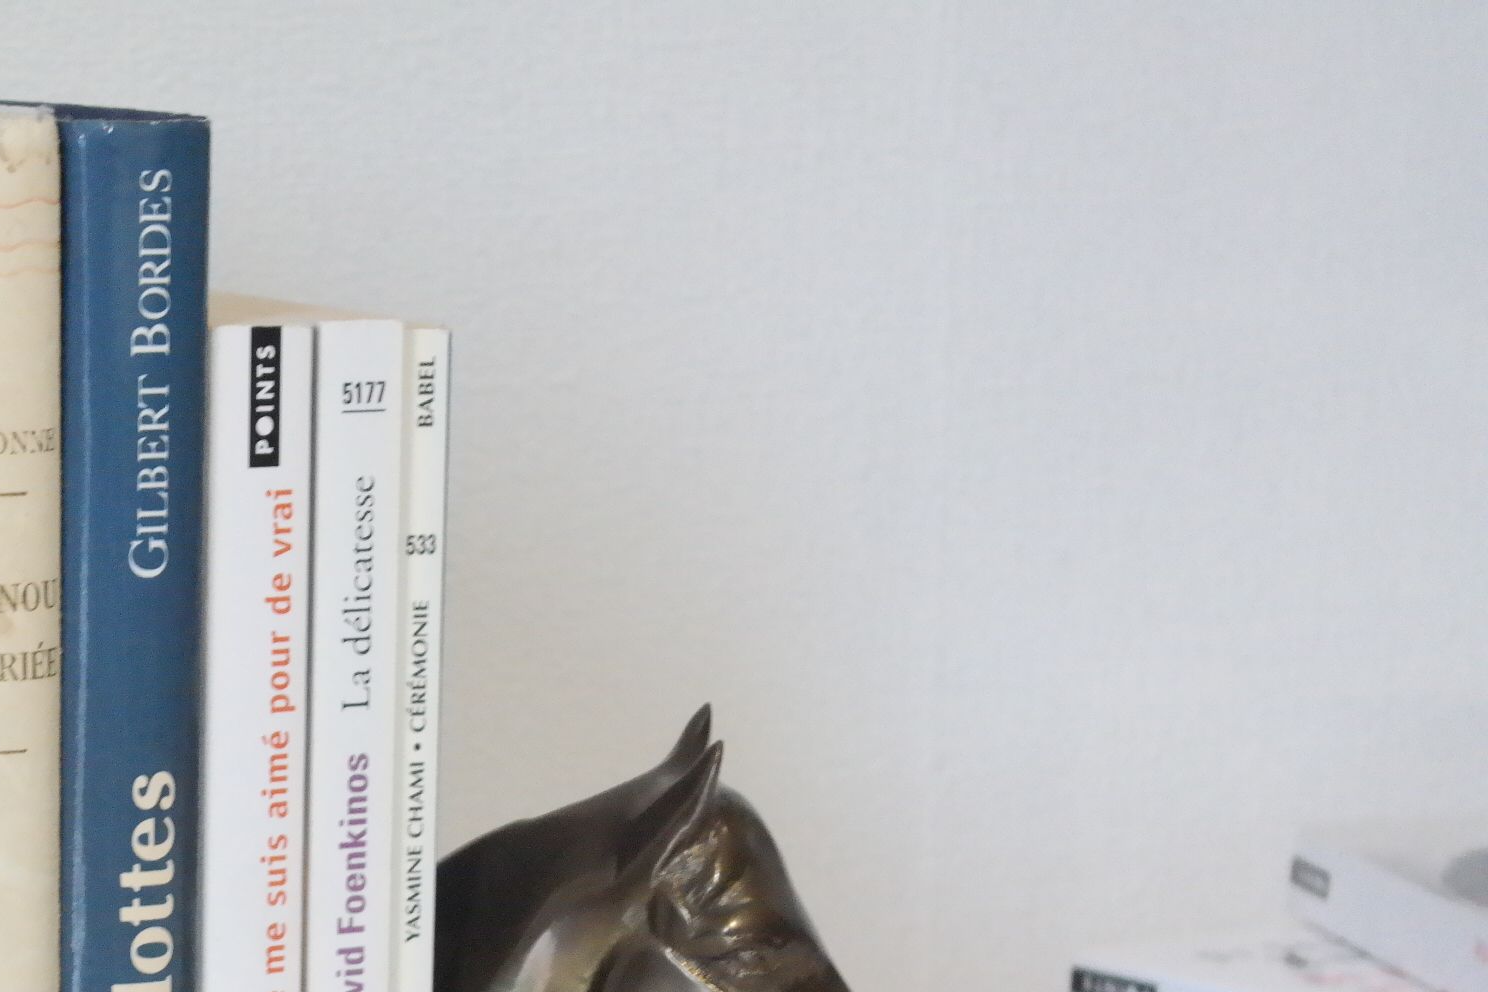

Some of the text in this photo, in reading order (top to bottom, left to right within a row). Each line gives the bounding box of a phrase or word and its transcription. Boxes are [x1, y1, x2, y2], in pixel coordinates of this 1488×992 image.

[254, 343, 276, 456] POINTS
[341, 380, 387, 406] 5177
[417, 356, 437, 428] BABEL
[264, 487, 295, 559] vrai
[405, 534, 437, 556] 533
[263, 571, 293, 616] de
[340, 474, 376, 712] La délicatesse
[267, 630, 297, 716] pour
[260, 729, 290, 820] aimé
[404, 600, 429, 943] YASMINE CHAMI CÉRÉMONIE
[259, 833, 289, 907] suis
[335, 751, 372, 935] Foenkinos
[264, 921, 288, 975] me
